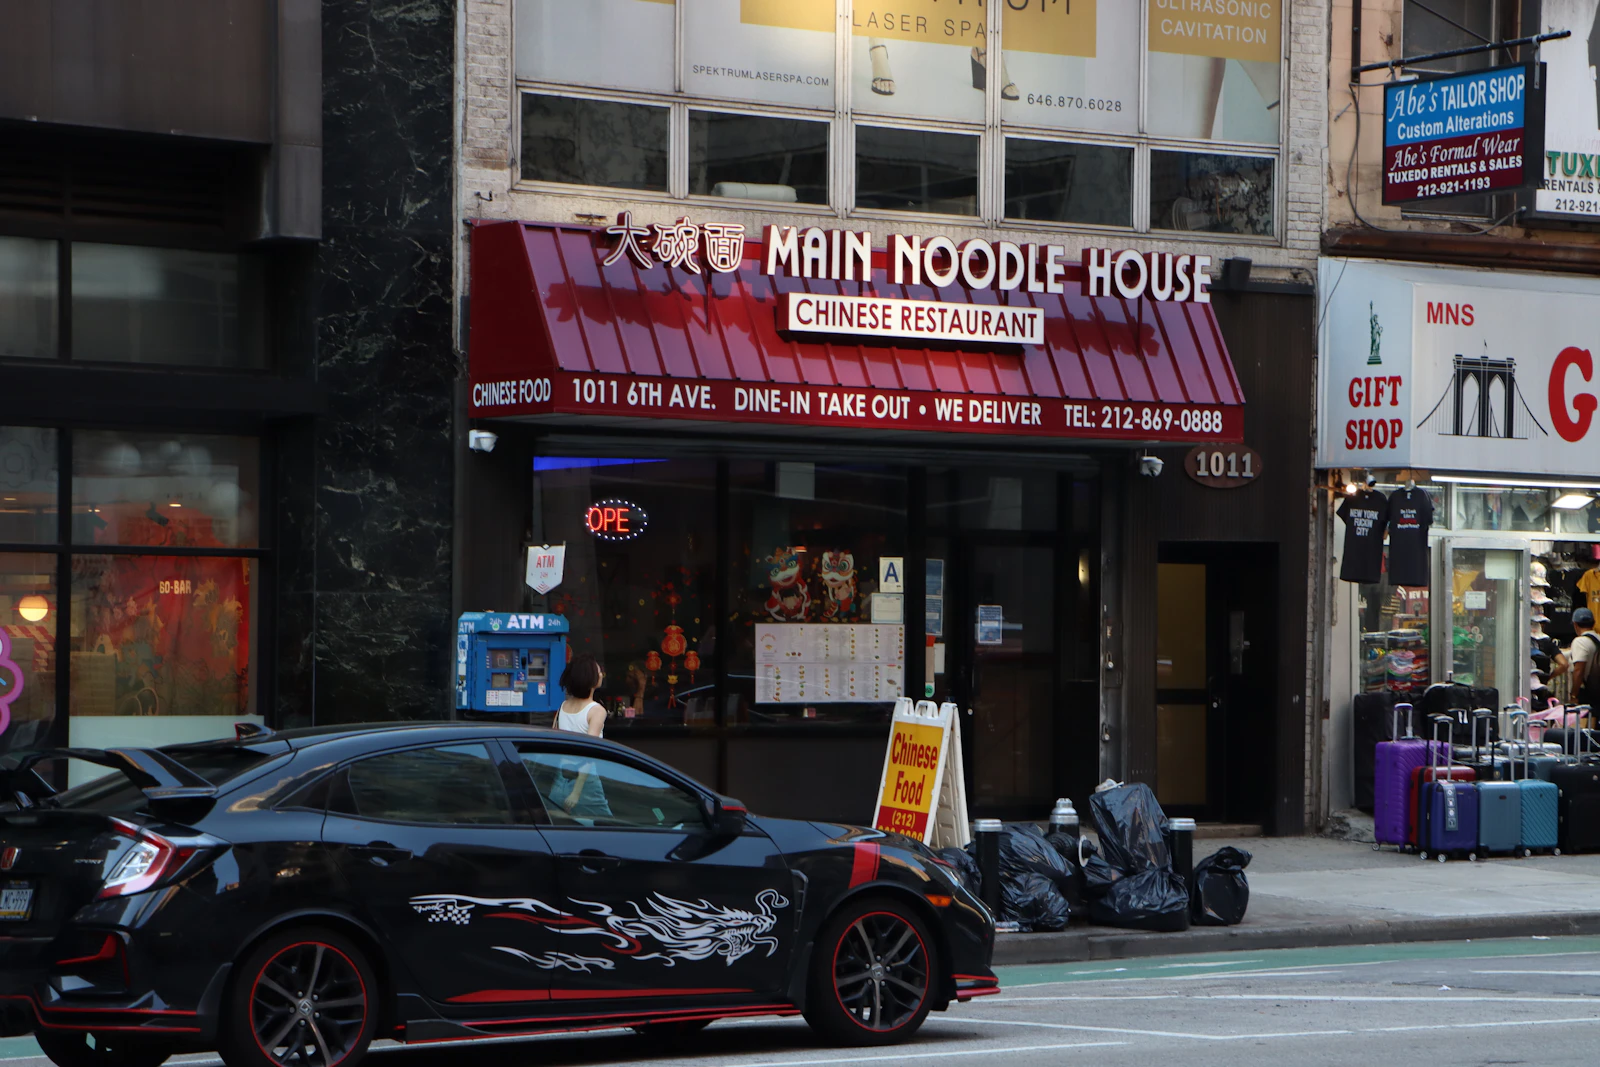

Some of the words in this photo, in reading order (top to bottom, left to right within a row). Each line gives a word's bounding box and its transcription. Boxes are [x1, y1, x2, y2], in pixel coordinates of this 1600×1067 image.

[852, 10, 927, 34] LASER
[943, 18, 987, 39] SPA
[1161, 19, 1267, 44] CAVITATION
[692, 64, 830, 87] SPEKTRUMLASERSPA.COM
[1027, 93, 1122, 113] 646.870.6028
[1388, 81, 1439, 123] Abe's
[1441, 80, 1487, 111] TAILOR
[1489, 74, 1525, 104] SHOP
[1397, 120, 1444, 140] Custom
[1446, 110, 1515, 133] Alterations
[1390, 145, 1428, 171] Abe's
[1429, 136, 1481, 163] Formal
[1482, 134, 1521, 156] Wear
[1546, 150, 1600, 179] TUX
[1388, 170, 1429, 184] TUXEDO
[1430, 162, 1477, 179] RENTALS
[1479, 160, 1487, 172] &
[1489, 155, 1523, 170] SALES
[1417, 176, 1491, 197] 212-921-1193
[1544, 179, 1594, 194] RENTALS
[603, 210, 746, 275] 大碗面
[766, 223, 872, 284] MAIN
[893, 234, 1066, 294] NOODLE
[1088, 247, 1212, 303] HOUSE
[796, 298, 894, 331] CHINESE
[901, 306, 1038, 339] RESTAURANT
[1426, 301, 1475, 326] MNS
[472, 380, 518, 408] CHINESE
[519, 377, 551, 403] FOOD
[573, 378, 618, 404] 1011
[627, 381, 663, 407] 6TH
[669, 384, 716, 410] AVE.
[734, 387, 811, 415] DINE-IN
[818, 391, 866, 418] TAKE
[871, 395, 911, 420] OUT
[935, 398, 964, 423] WE
[968, 400, 1042, 426] DELIVER
[1064, 404, 1096, 429] TEL:
[1101, 406, 1223, 434] 212-869-0888
[1348, 375, 1402, 408] GIFT
[1548, 346, 1599, 442] G
[1345, 418, 1404, 450] SHOP
[1196, 450, 1254, 478] 1011
[588, 507, 630, 532] OPE
[1349, 508, 1363, 518] NEW
[1363, 510, 1379, 520] YORK
[1355, 527, 1370, 536] CITY
[536, 555, 555, 568] ATM
[884, 562, 899, 582] A
[459, 622, 475, 633] ATM
[507, 615, 544, 629] ATM
[891, 732, 938, 770] Chinese
[893, 770, 926, 806] Food
[892, 810, 916, 829] (212)
